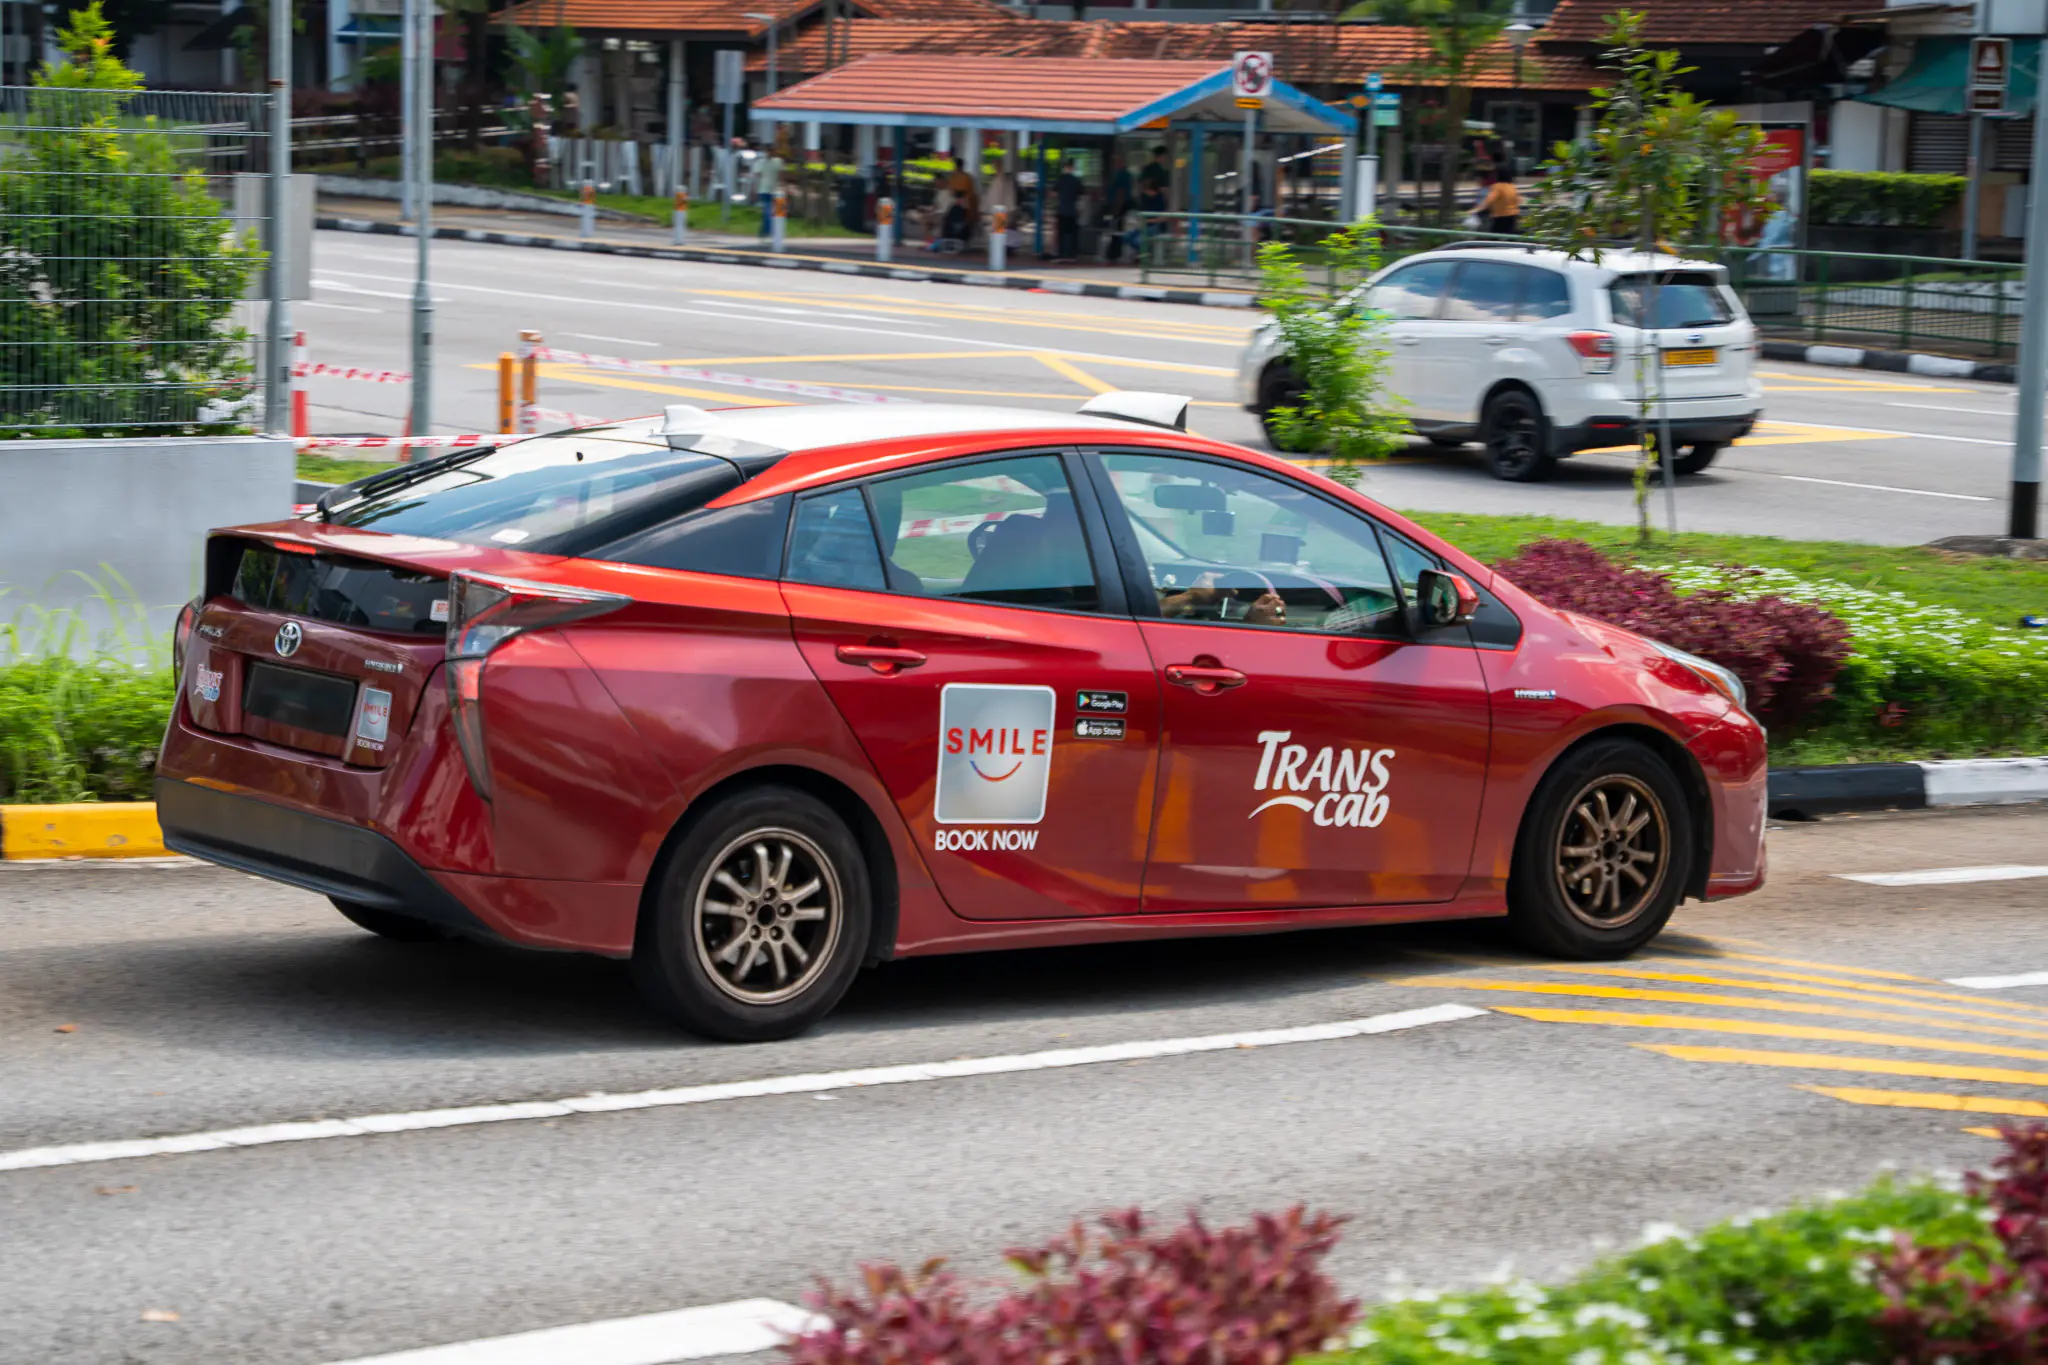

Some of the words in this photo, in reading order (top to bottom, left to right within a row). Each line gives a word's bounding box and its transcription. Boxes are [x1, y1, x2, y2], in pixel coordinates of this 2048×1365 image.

[364, 703, 388, 716] SMILE
[1091, 700, 1111, 709] Google
[1111, 700, 1124, 710] Play
[945, 727, 1048, 756] SMILE
[1088, 727, 1102, 736] App
[1103, 727, 1122, 736] Store
[1253, 729, 1396, 793] TRANS
[1313, 791, 1391, 828] cab
[934, 829, 989, 851] BOOK
[991, 829, 1039, 851] NOW
